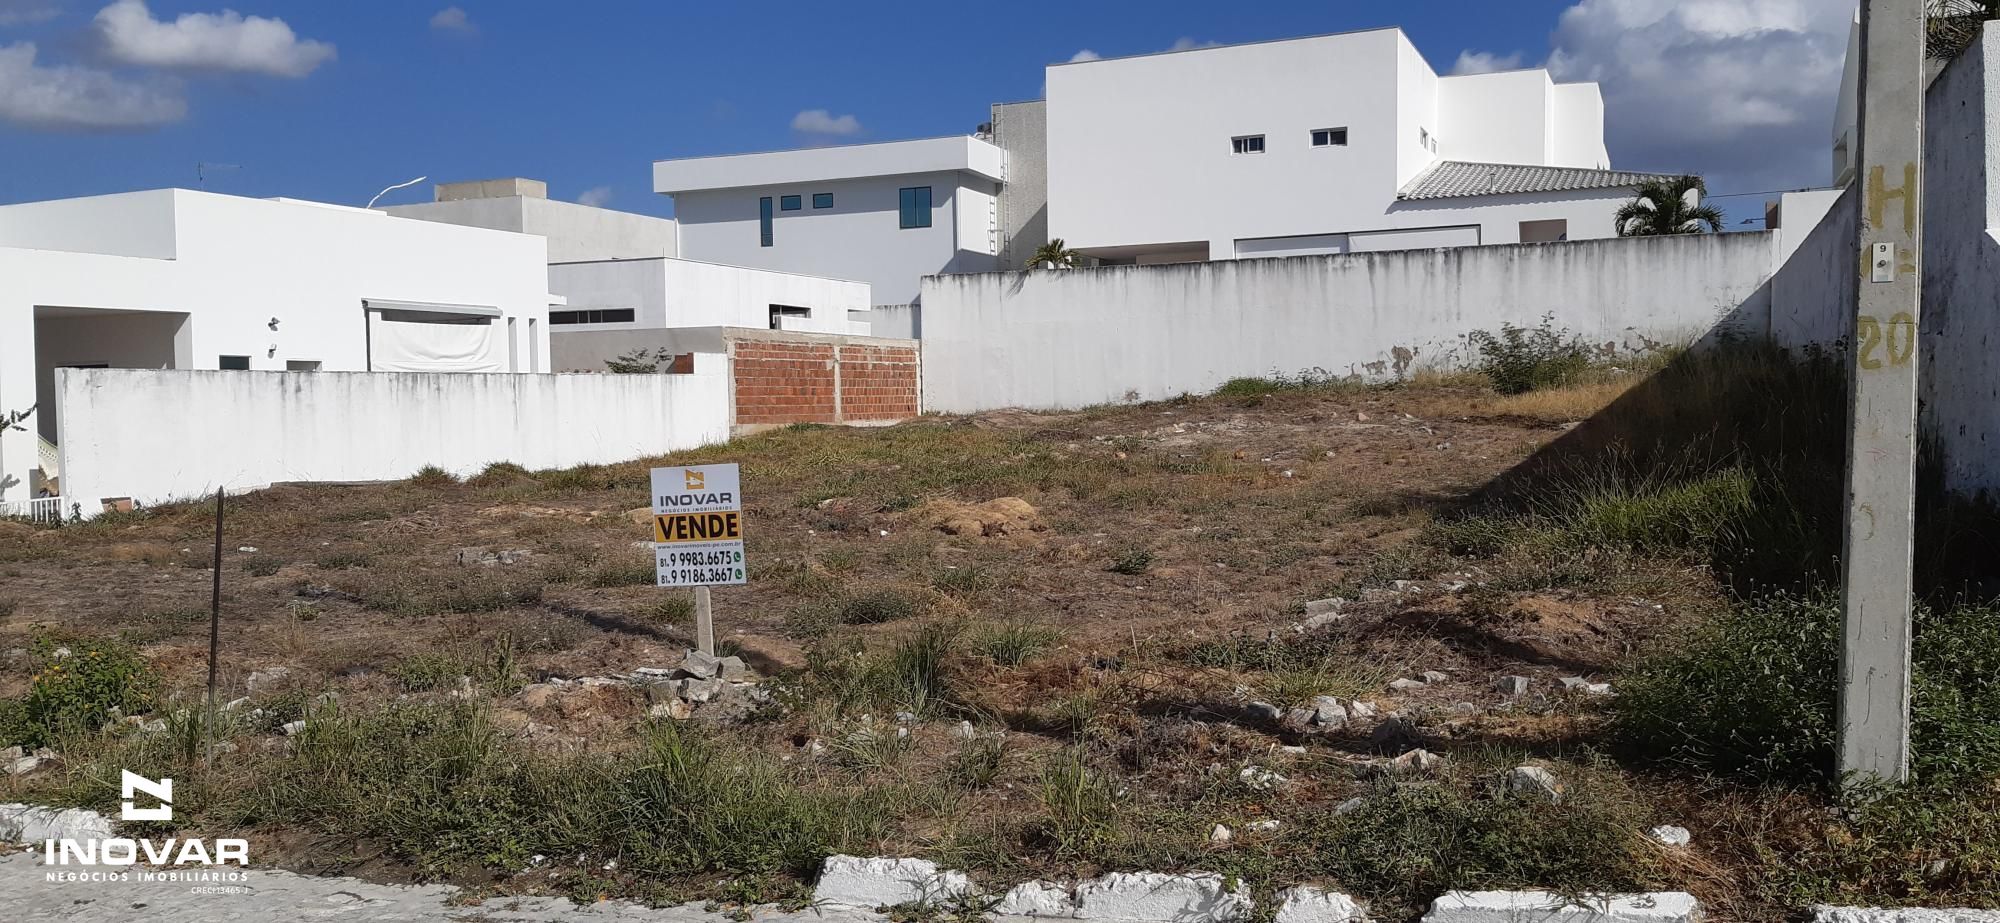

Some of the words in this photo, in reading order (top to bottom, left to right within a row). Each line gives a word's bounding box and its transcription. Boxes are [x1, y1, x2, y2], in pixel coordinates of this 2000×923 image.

[1868, 161, 1917, 239] H
[1879, 244, 1887, 253] 9
[1858, 311, 1915, 370] 20
[660, 492, 732, 507] INOVAR
[658, 513, 738, 540] VENDE
[680, 551, 732, 567] 9983.6675
[681, 568, 733, 583] 9186.3667
